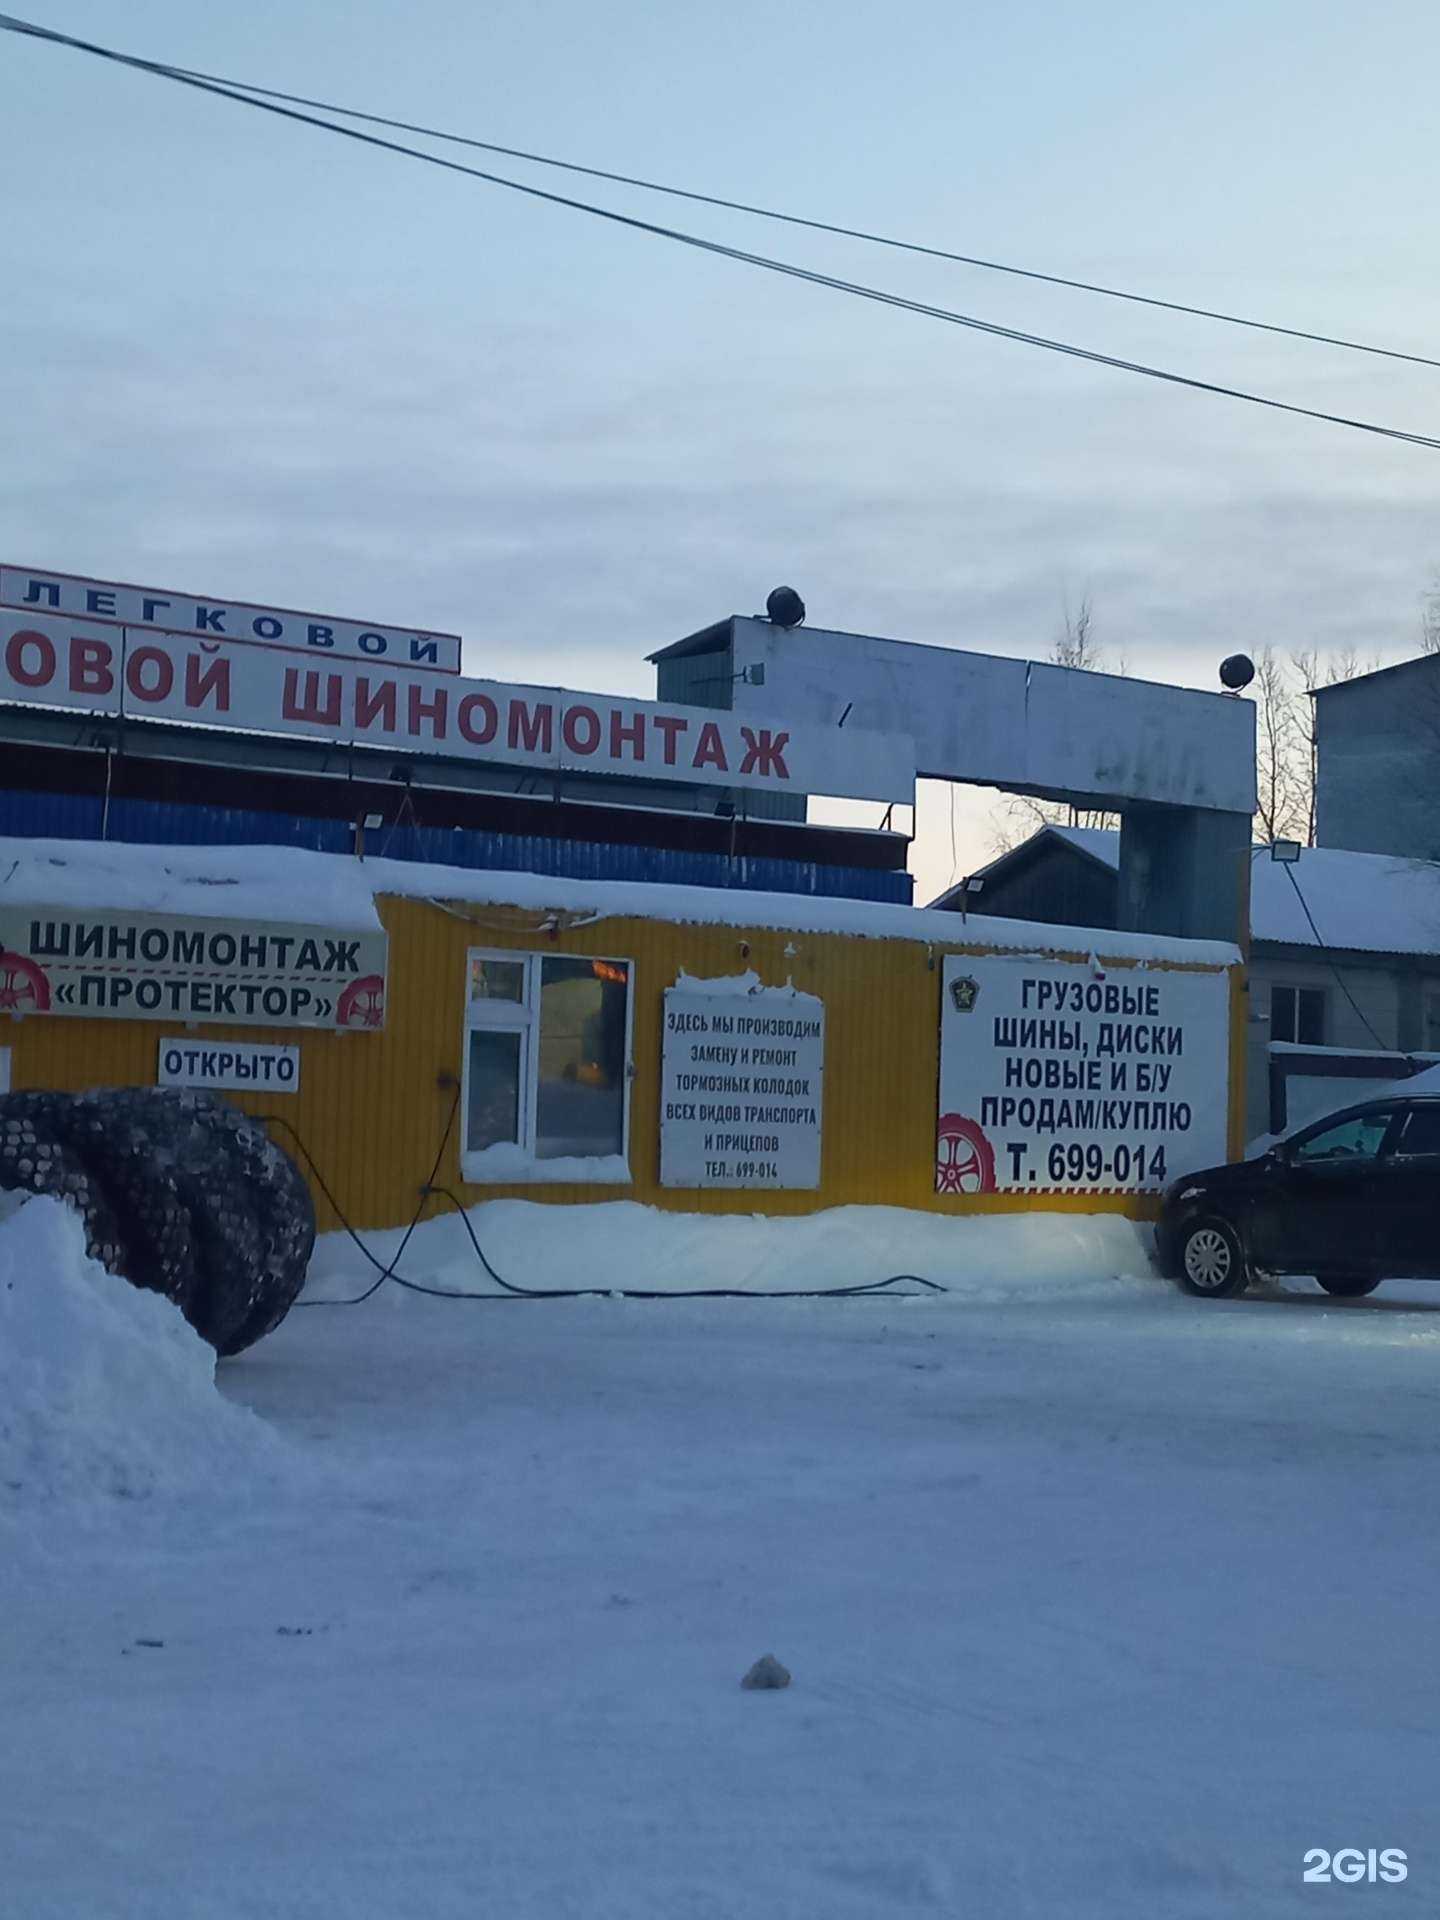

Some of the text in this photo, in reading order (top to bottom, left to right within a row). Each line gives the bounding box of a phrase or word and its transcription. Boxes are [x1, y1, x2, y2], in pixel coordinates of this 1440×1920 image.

[22, 579, 439, 664] ЛЕГКОВОЙ
[282, 667, 790, 779] ШИНОМОНТАЖ
[29, 921, 361, 973] ШИНОМОНТАЖ
[55, 975, 332, 1018] «ПРОТЕКТОР»
[1021, 979, 1160, 1017] ГРУЗОВЫЕ
[712, 1015, 734, 1034] МЫ
[737, 1017, 821, 1039] ПРОИЗВОДИМ
[993, 1017, 1183, 1058] ШИНЫ, ДИСКИ
[164, 1049, 295, 1082] ОТКРЫТО
[691, 1045, 797, 1066] ЗАМЕНУ И РЕМОНТ
[676, 1074, 810, 1098] ТОРМОЗНЫХ КОЛОДОК
[1005, 1057, 1172, 1093] НОВЫЕ И Б/У
[666, 1103, 817, 1125] ВСЕХ ВИДОВ ТРАНСПОРТА
[981, 1096, 1192, 1134] ПРОДАМ/КУПЛЮ
[704, 1134, 780, 1155] И ПРИЦЕПОВ
[1007, 1142, 1168, 1183] Т. 699-014
[735, 1161, 778, 1179] 699-014
